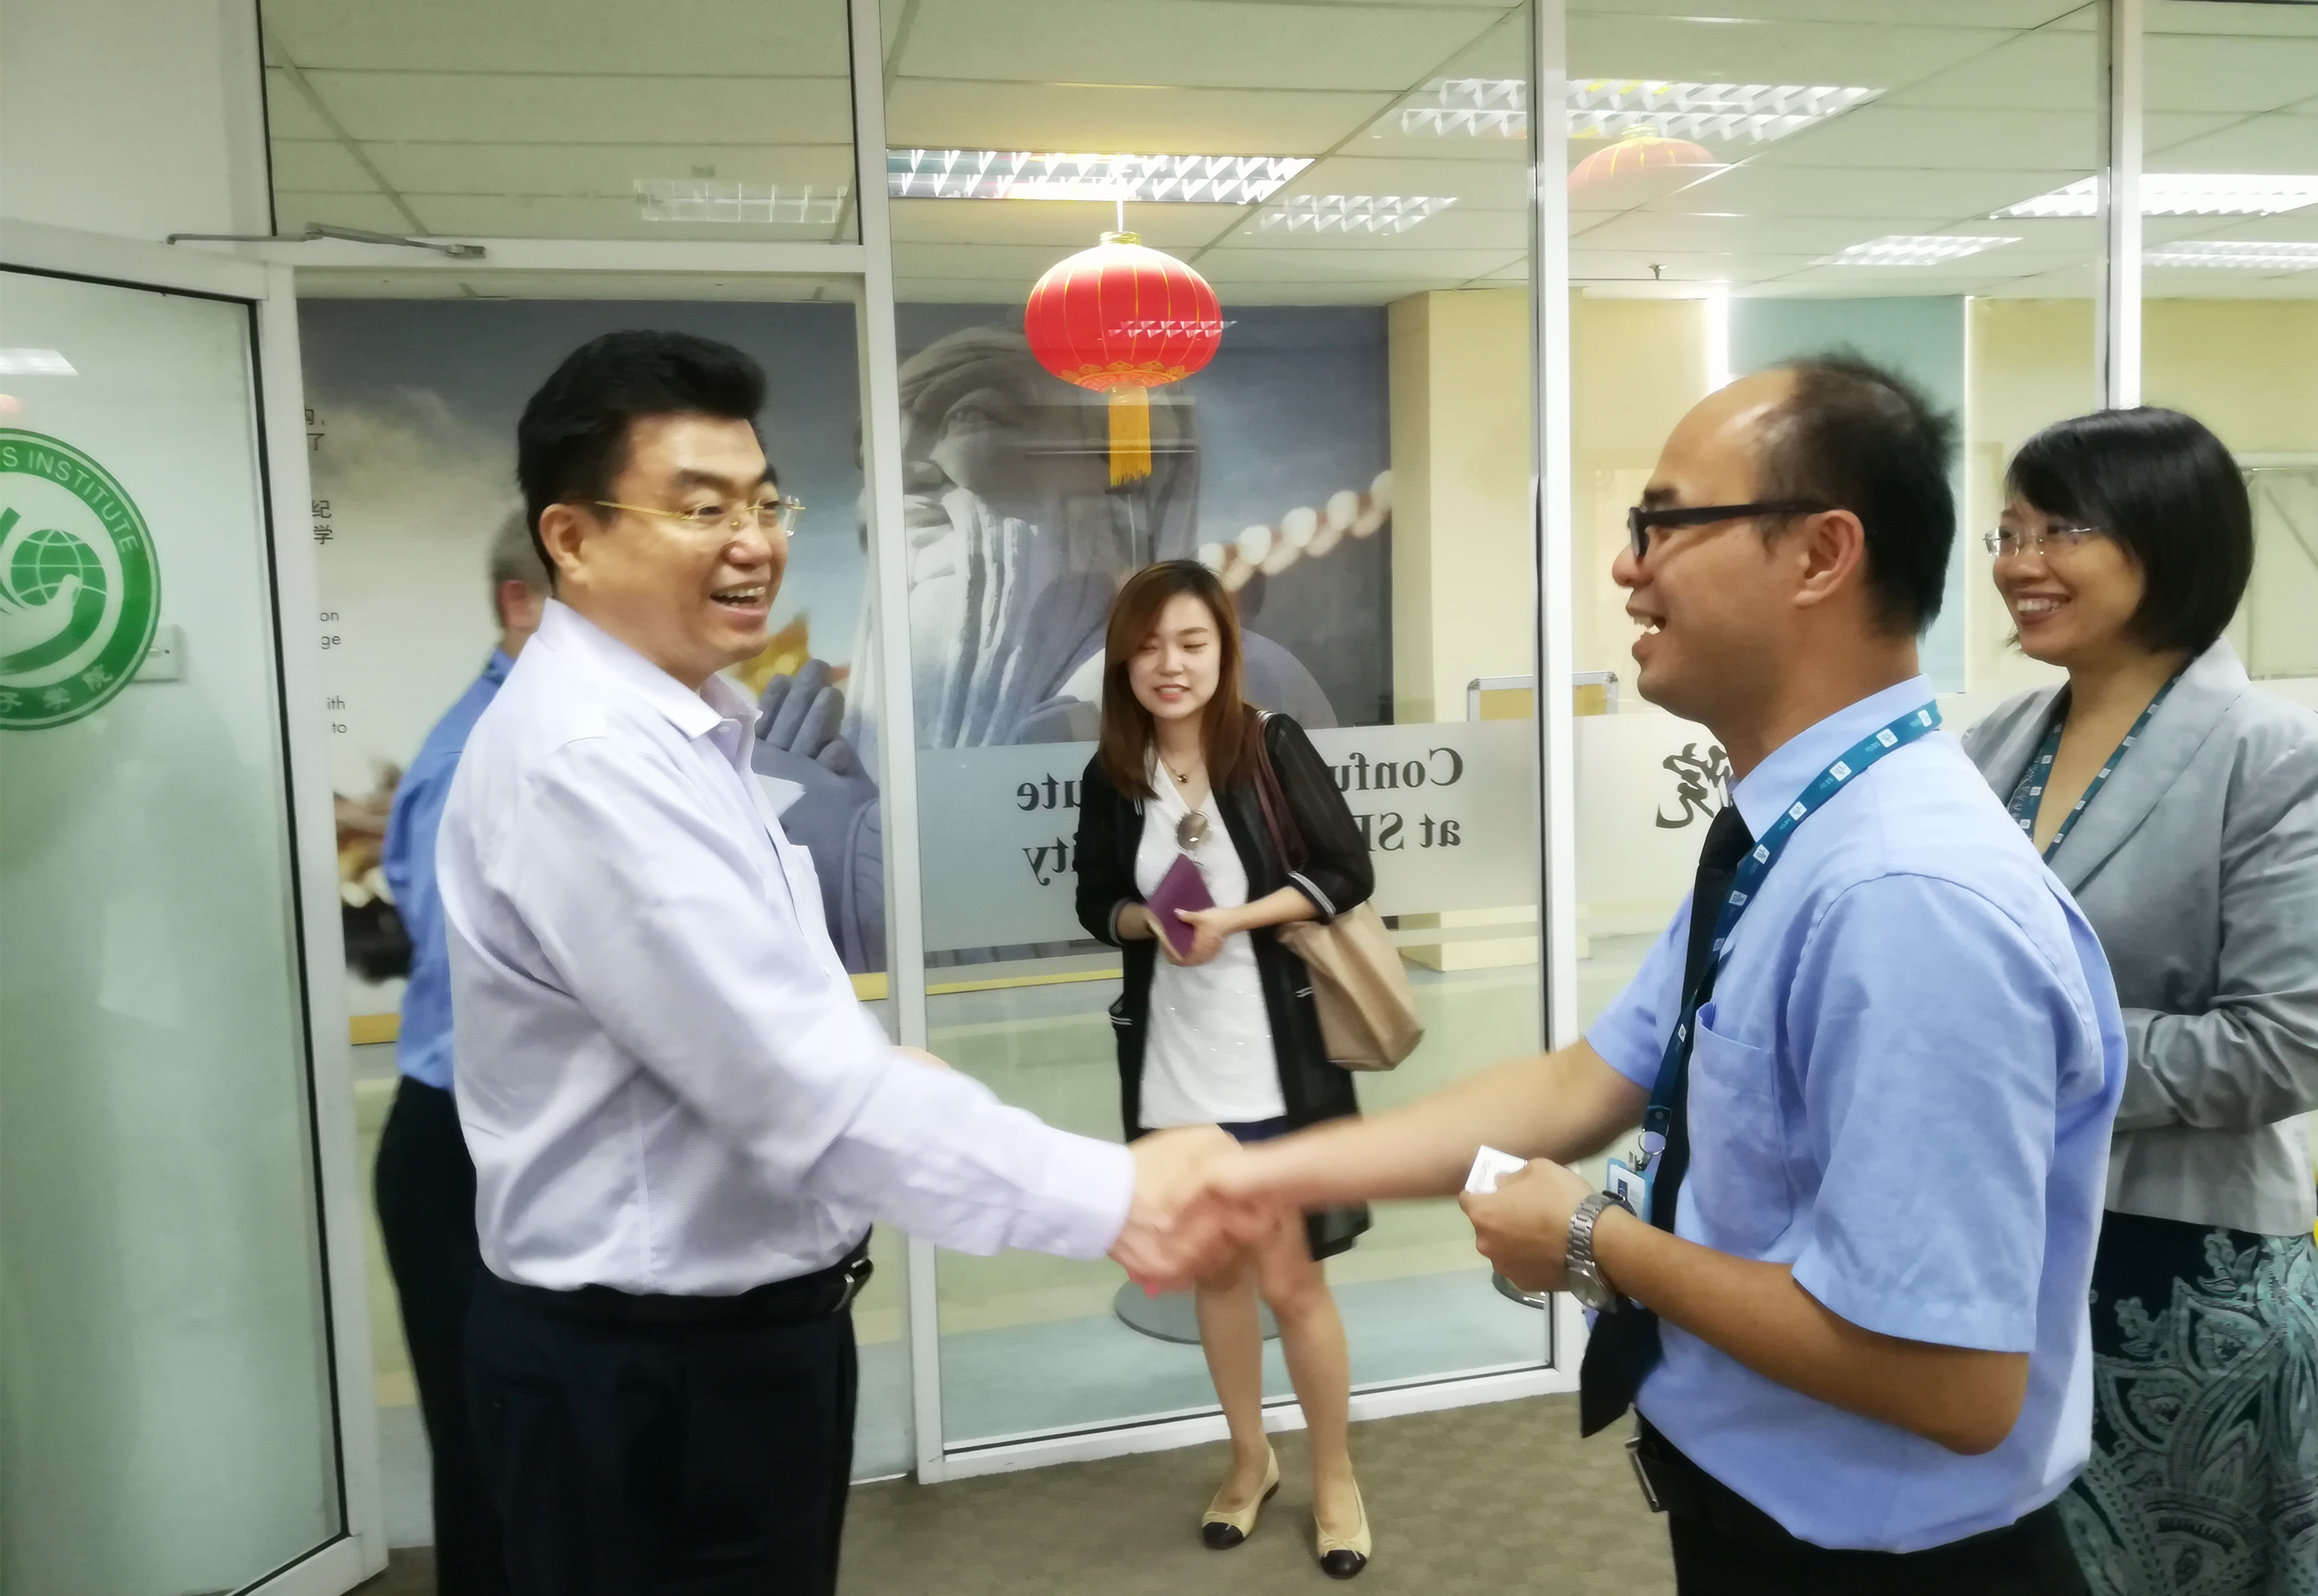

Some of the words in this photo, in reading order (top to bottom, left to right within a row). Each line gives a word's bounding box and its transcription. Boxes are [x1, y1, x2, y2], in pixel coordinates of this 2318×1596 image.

[28, 450, 139, 554] INSTITUTE
[313, 524, 334, 545] 学
[320, 612, 339, 622] on
[321, 635, 341, 650] ge
[331, 722, 348, 733] to
